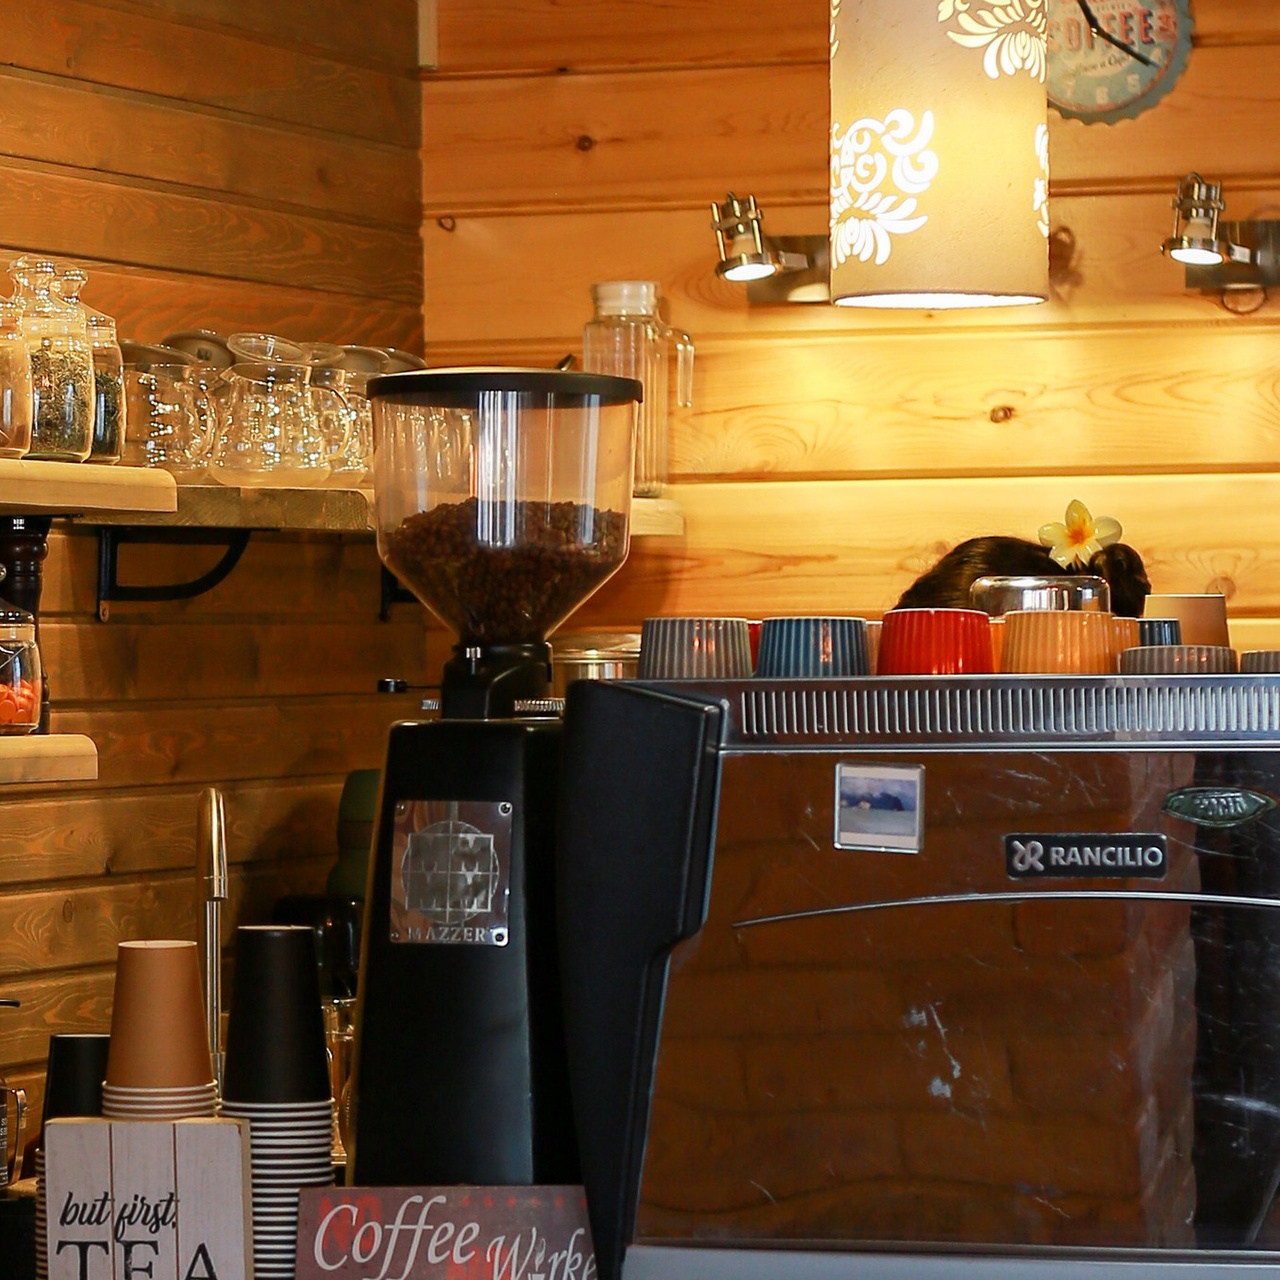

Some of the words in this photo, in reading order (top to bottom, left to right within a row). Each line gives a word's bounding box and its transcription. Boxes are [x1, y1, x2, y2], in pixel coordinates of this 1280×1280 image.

[1050, 845, 1164, 867] RANCILIO
[406, 926, 487, 942] MAZZER
[60, 1191, 114, 1227] but
